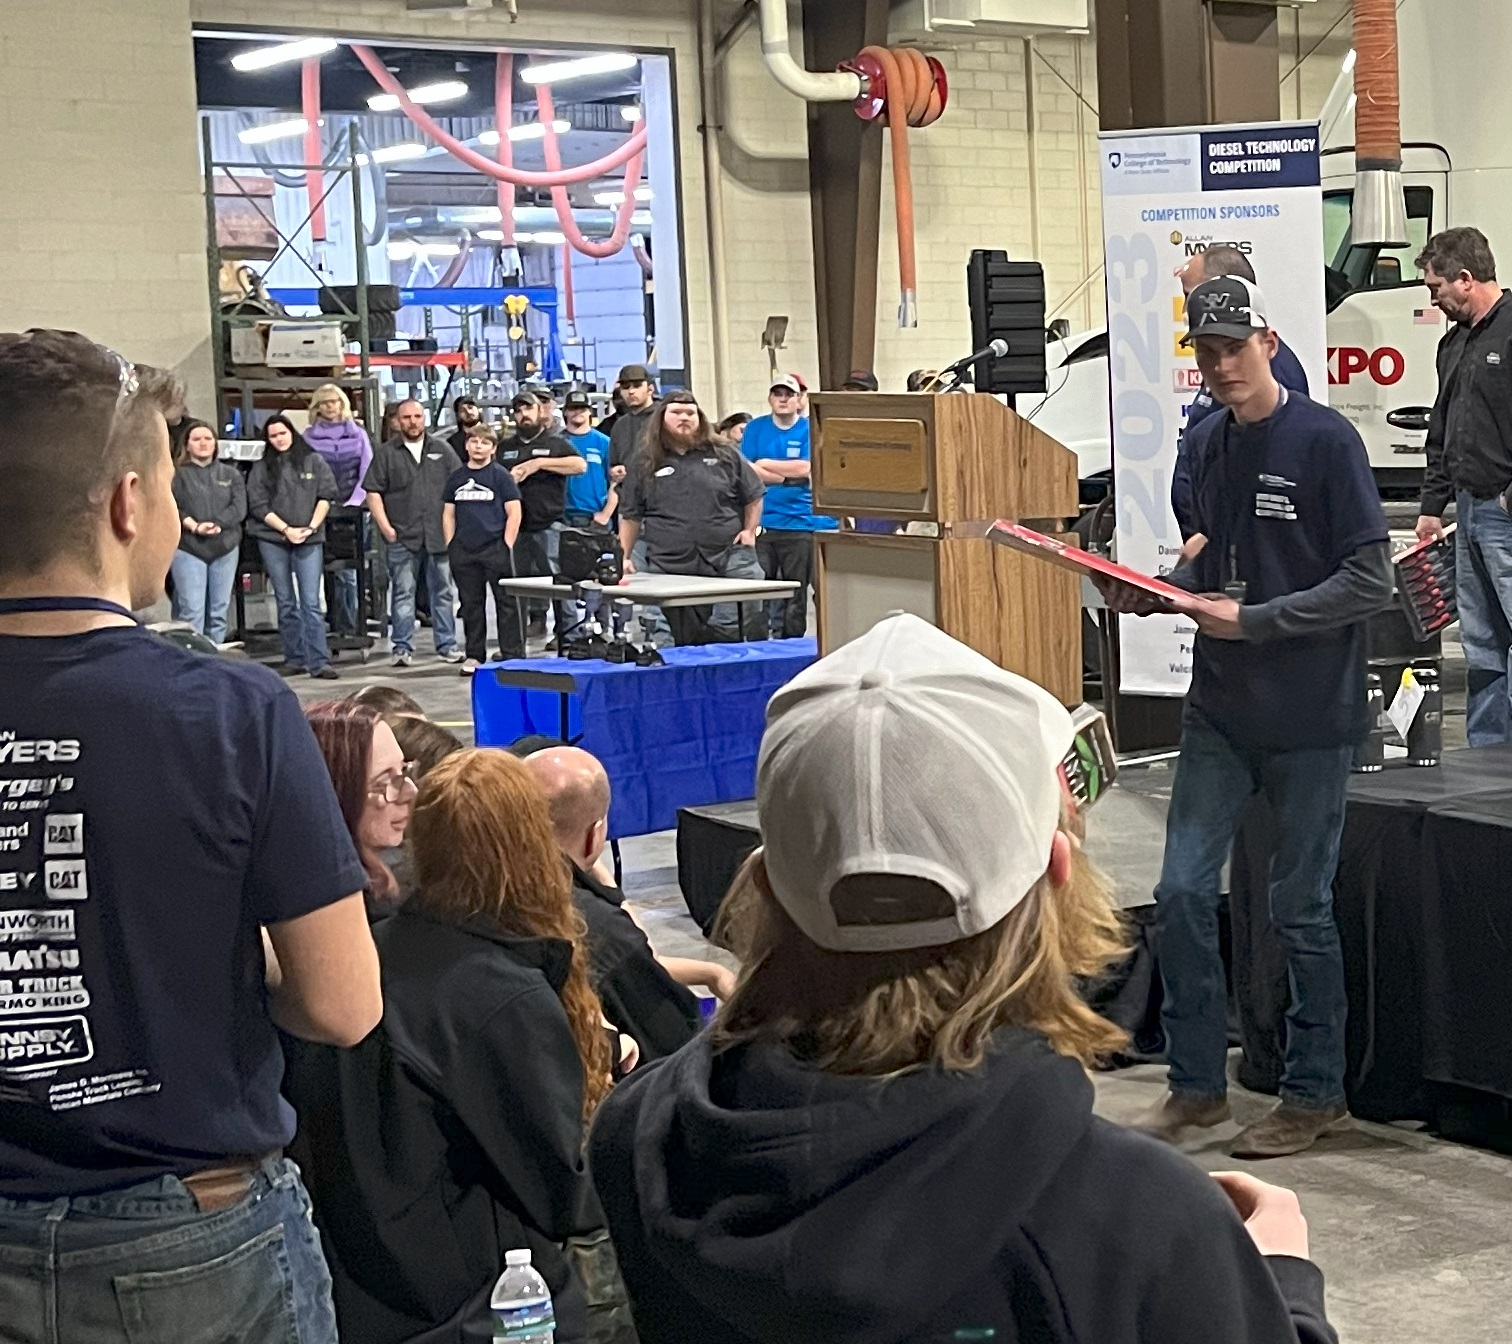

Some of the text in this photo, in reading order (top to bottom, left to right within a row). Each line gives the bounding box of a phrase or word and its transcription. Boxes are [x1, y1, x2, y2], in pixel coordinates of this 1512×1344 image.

[1209, 139, 1315, 156] DIESEL TECHNOLOGY
[1209, 158, 1280, 174] COMPETITION
[1141, 204, 1280, 222] COMPETITION SPONSORS
[1108, 232, 1168, 539] 2023
[48, 825, 78, 843] CAT
[50, 871, 82, 889] CAT
[19, 975, 83, 994] TRUCK
[42, 994, 85, 1007] KING
